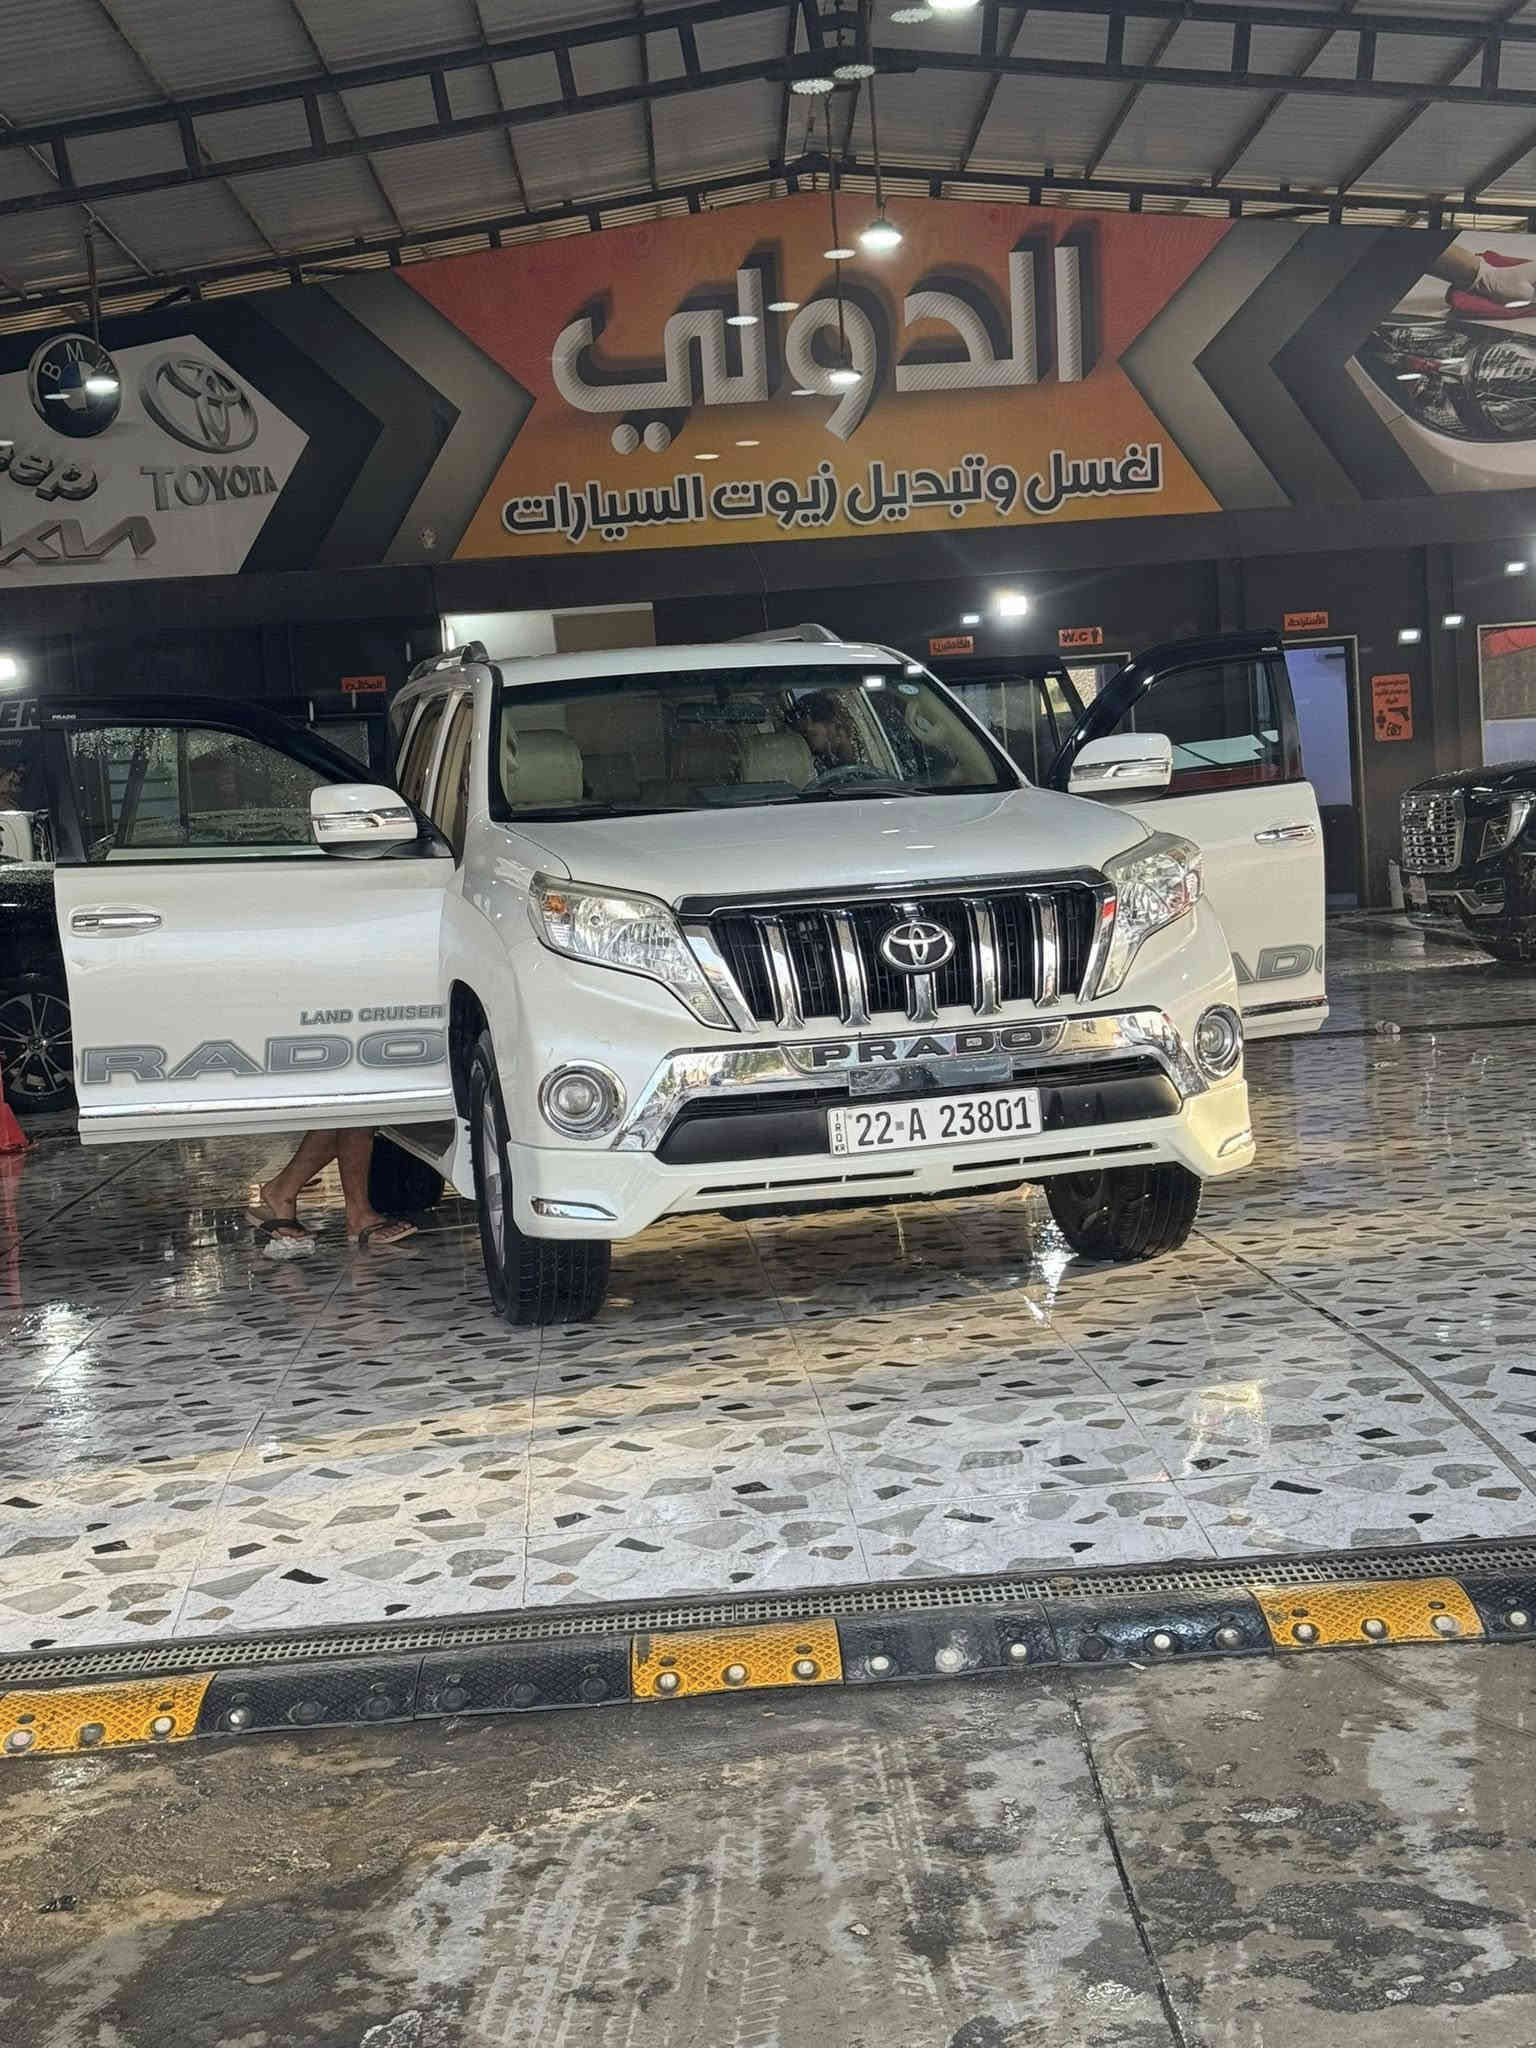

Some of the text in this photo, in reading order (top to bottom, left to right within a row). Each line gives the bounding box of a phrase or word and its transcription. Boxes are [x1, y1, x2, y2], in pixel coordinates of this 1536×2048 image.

[552, 246, 1083, 454] الدولي
[140, 464, 278, 512] TOYOTA
[502, 444, 1162, 544] لغسل وتبديل زيوت السيارات
[301, 1004, 445, 1026] LAND CRUISER
[812, 1026, 1044, 1067] PRADO
[855, 1096, 1032, 1146] 22 A 23801
